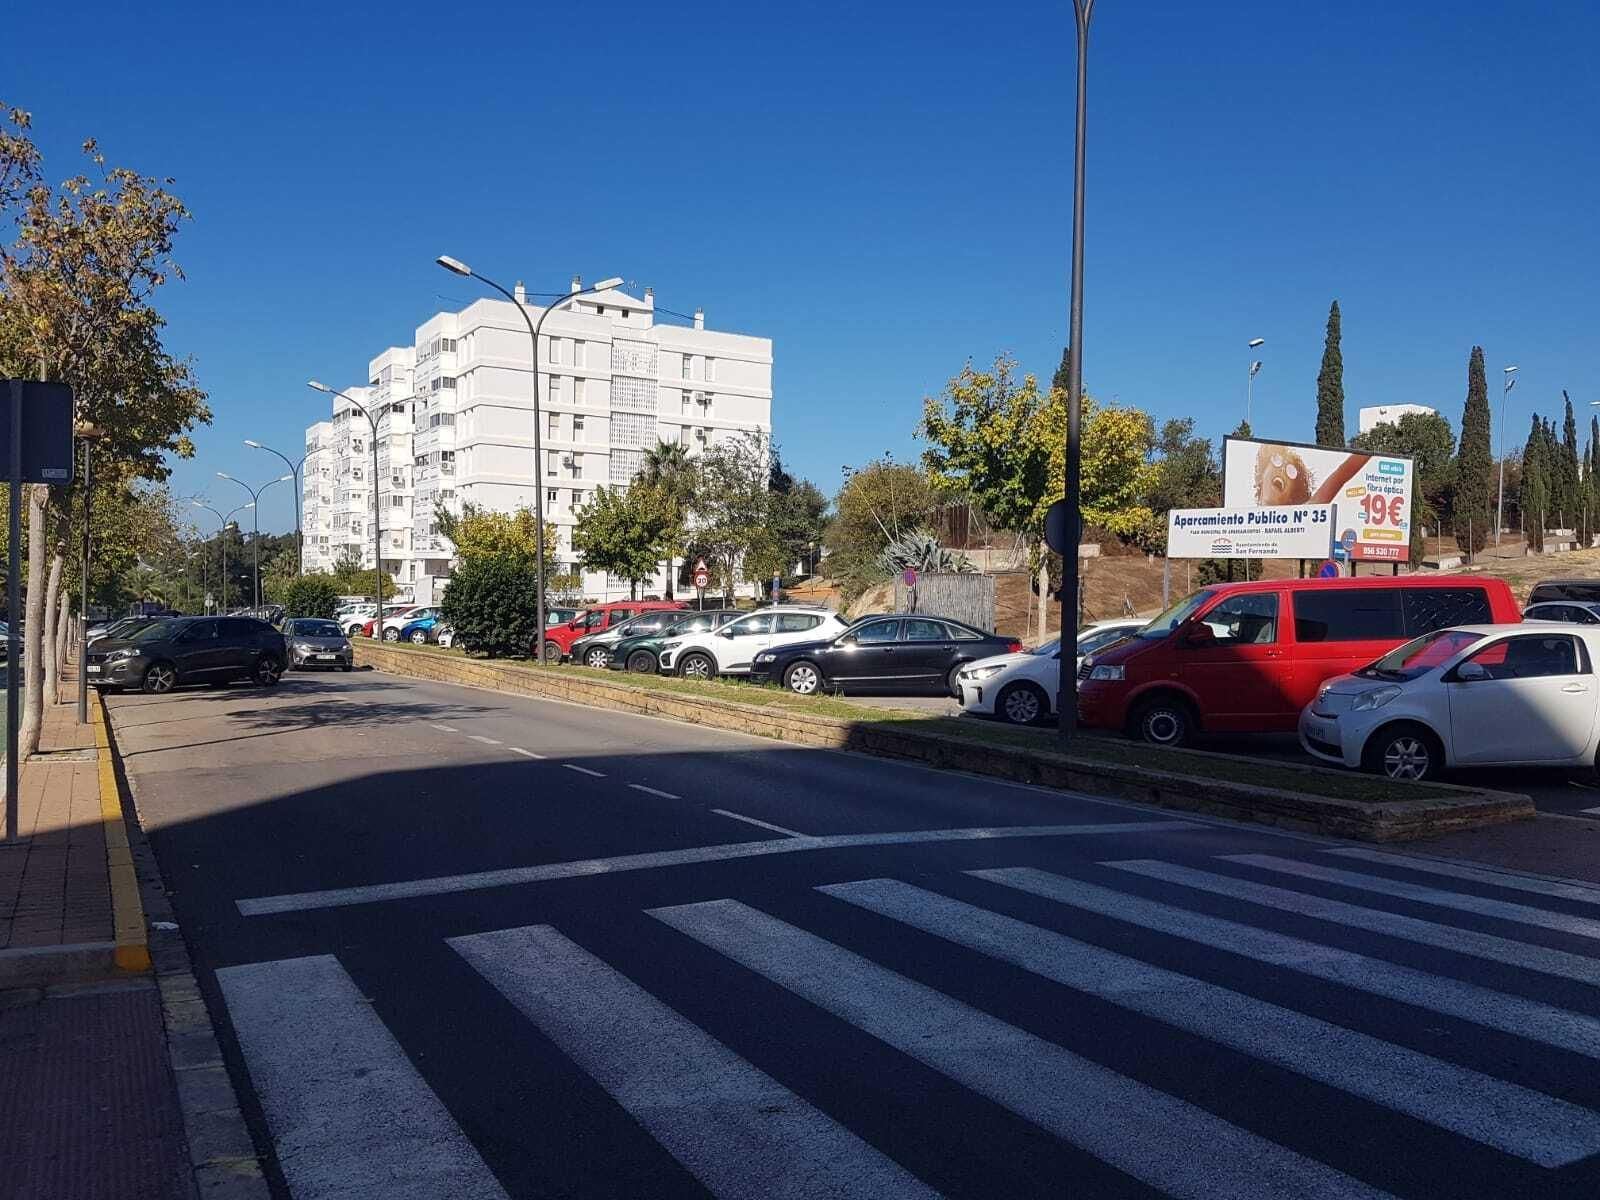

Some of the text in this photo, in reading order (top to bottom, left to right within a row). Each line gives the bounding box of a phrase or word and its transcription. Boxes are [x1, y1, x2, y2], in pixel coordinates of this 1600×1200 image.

[1366, 473, 1391, 483] Internet
[1367, 483, 1404, 495] fibra óptica
[1360, 494, 1405, 527] 19€
[1174, 513, 1244, 529] Aparcamiento
[1247, 511, 1288, 525] Público
[1312, 510, 1327, 523] 35
[1389, 548, 1400, 556] 777
